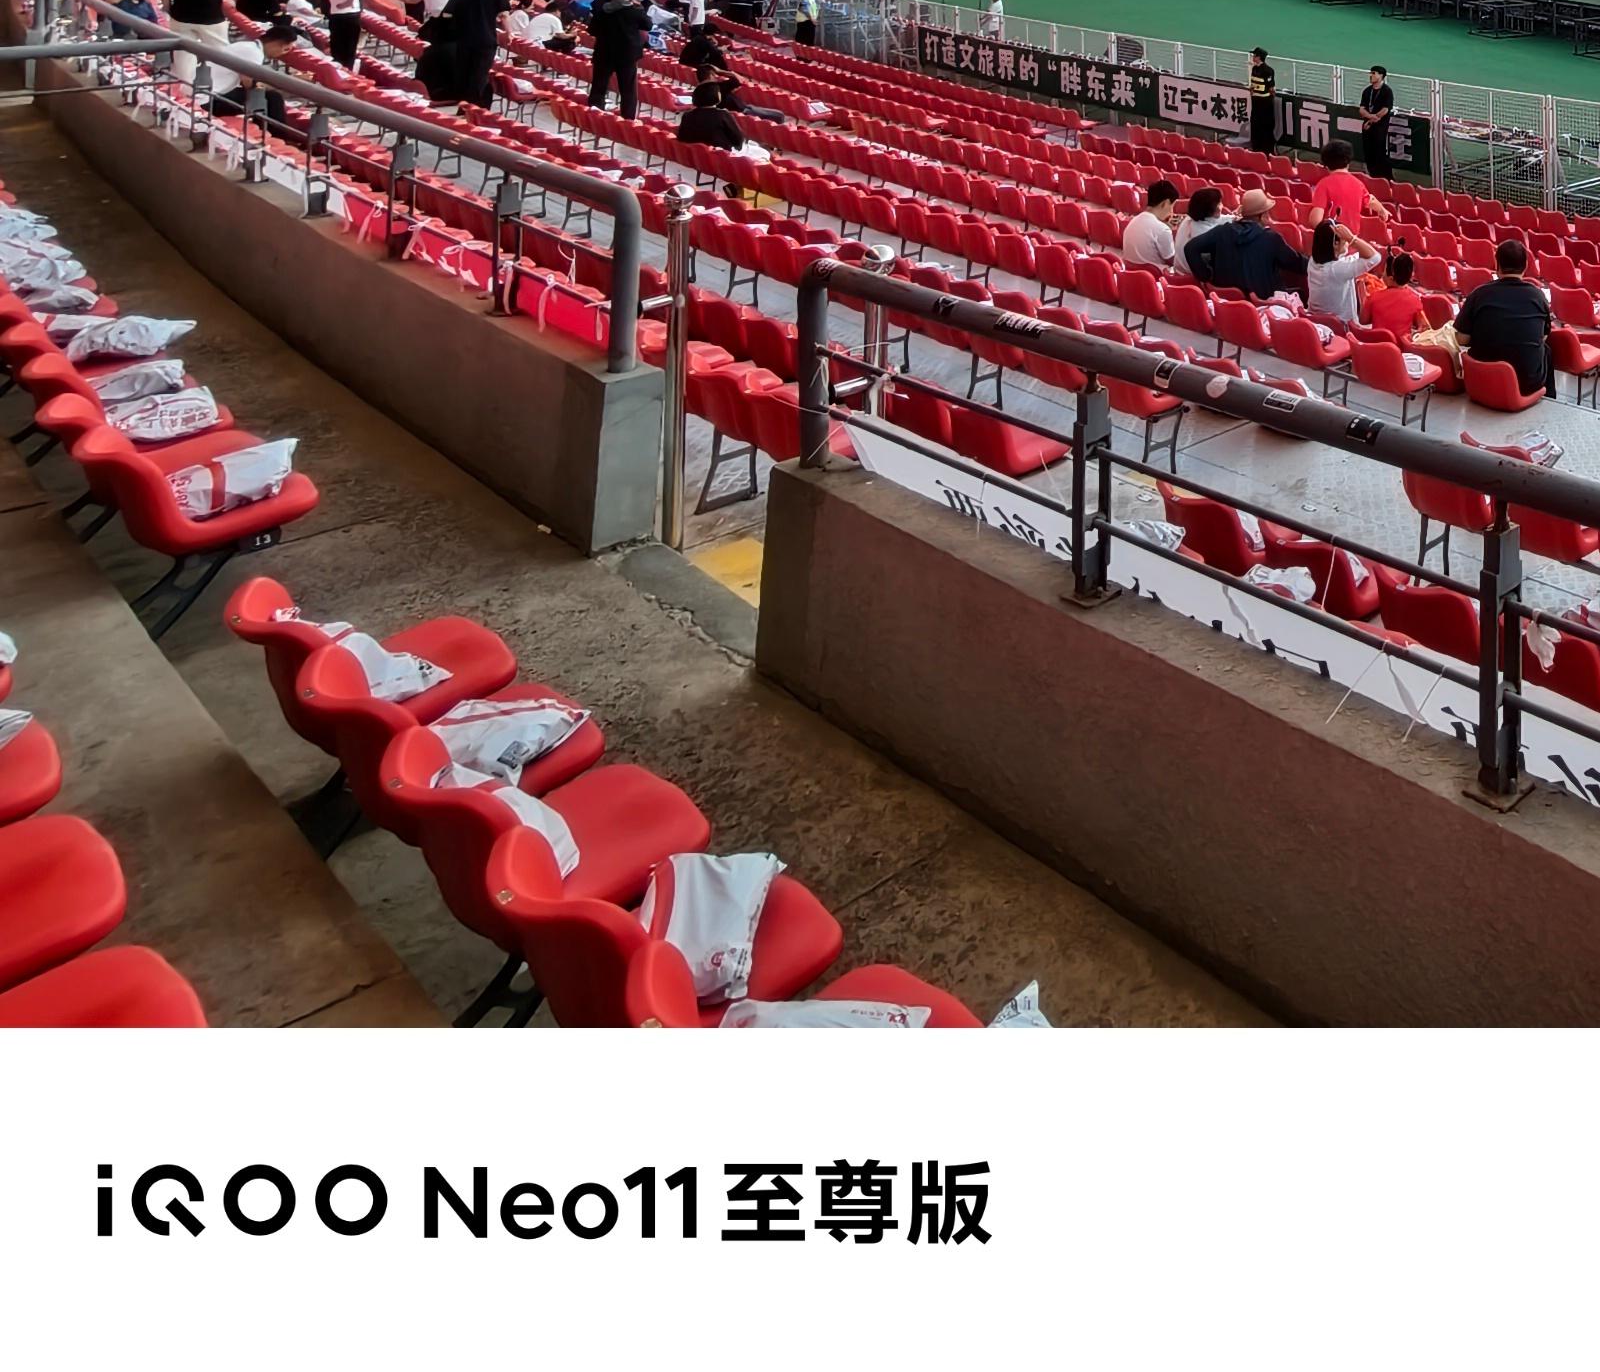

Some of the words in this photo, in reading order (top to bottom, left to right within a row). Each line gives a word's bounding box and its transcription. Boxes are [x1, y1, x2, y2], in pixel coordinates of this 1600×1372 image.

[925, 32, 1150, 108] 打造文旅界的“胖东来”
